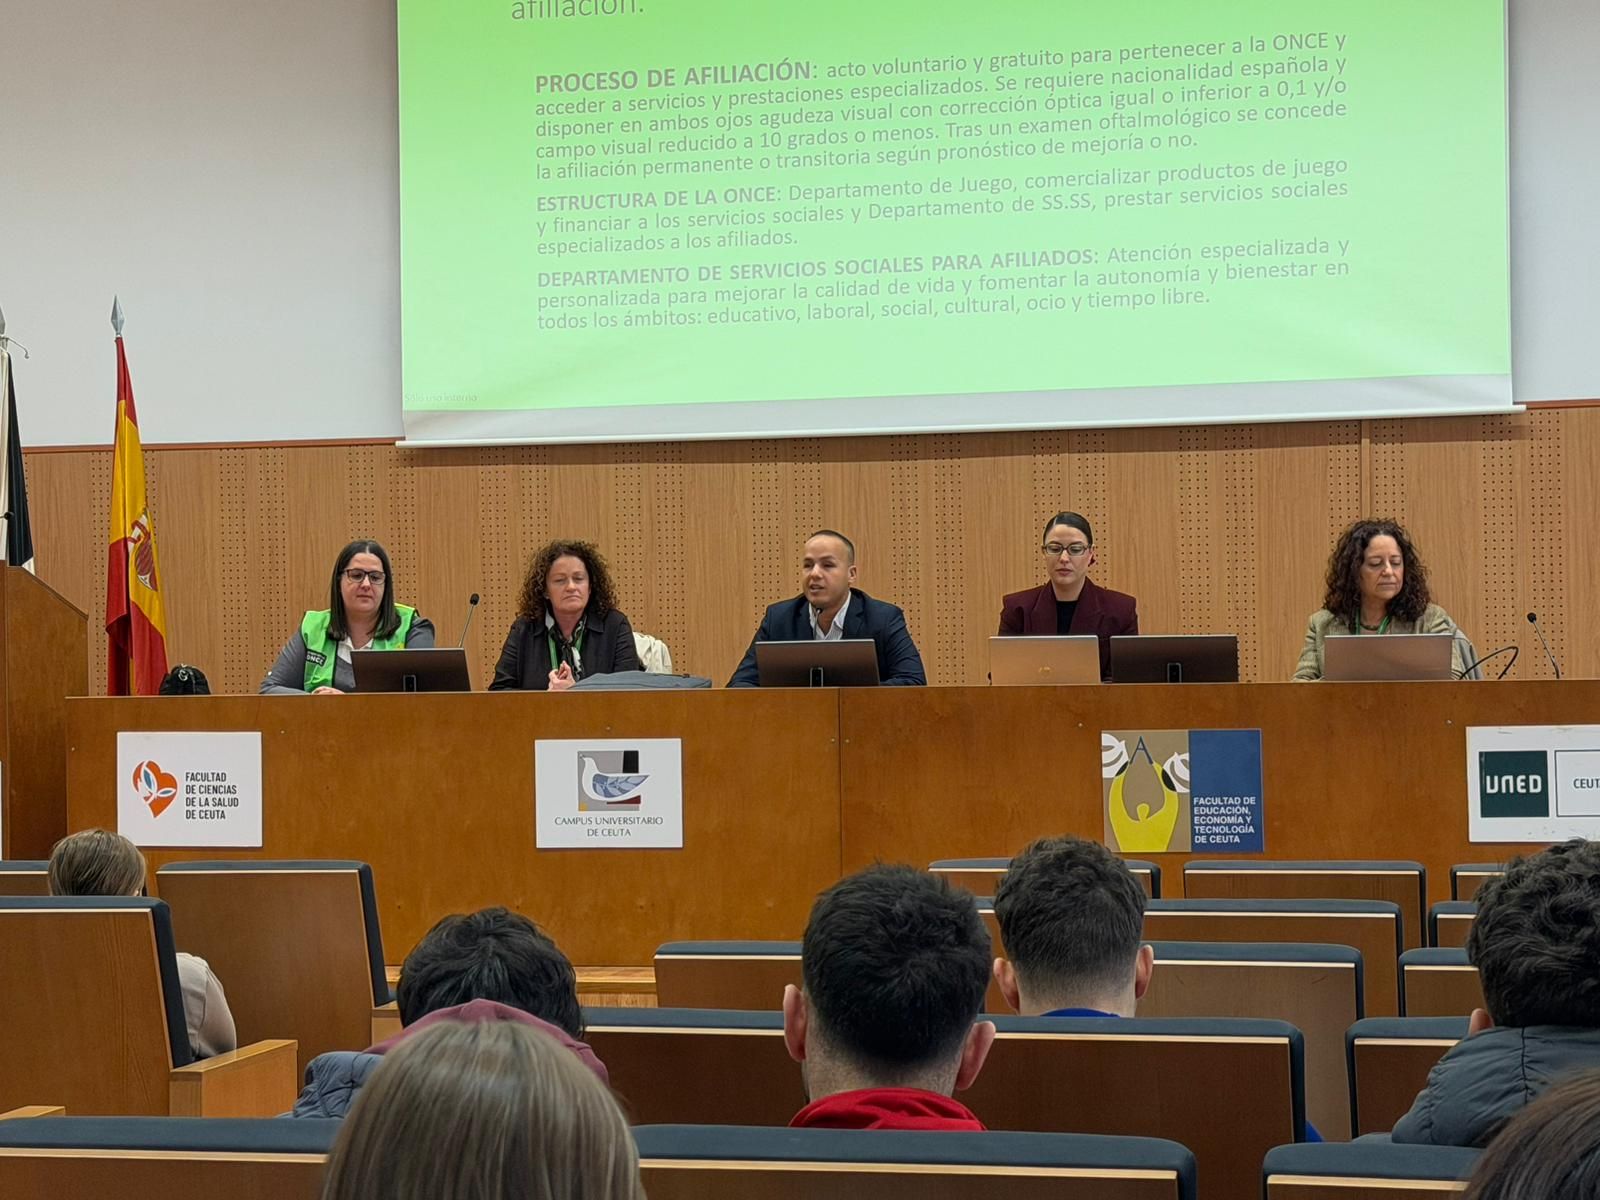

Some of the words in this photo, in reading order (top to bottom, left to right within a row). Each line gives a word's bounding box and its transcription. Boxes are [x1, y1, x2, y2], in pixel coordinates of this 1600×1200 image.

[536, 70, 638, 93] PROCESO
[648, 68, 676, 88] DE
[684, 58, 817, 86] AFILIACIÓN:
[827, 62, 866, 78] acto
[872, 55, 967, 75] voluntario
[973, 57, 983, 74] y
[990, 50, 1064, 72] gratuito
[1071, 50, 1112, 68] para
[1120, 42, 1226, 65] pertenecer
[1232, 41, 1242, 54] a
[1250, 35, 1265, 52] la
[1273, 32, 1328, 51] ONCE
[1335, 34, 1346, 51] y
[536, 97, 606, 116] acceder
[612, 100, 621, 112] a
[628, 92, 706, 111] servicios
[712, 94, 722, 111] y
[729, 87, 844, 110] prestaciones
[850, 77, 988, 102] especializados.
[995, 76, 1016, 91] Se
[1025, 71, 1104, 92] requiere
[1112, 60, 1232, 84] nacionalidad
[1241, 56, 1328, 79] española
[1336, 58, 1346, 75] y
[536, 120, 614, 140] disponer
[620, 120, 642, 133] en
[649, 114, 709, 132] ambos
[716, 112, 752, 131] ojos
[760, 107, 833, 129] agudeza
[840, 102, 892, 121] visual
[900, 105, 932, 118] con
[940, 95, 1037, 116] corrección
[1044, 92, 1102, 113] óptica
[1110, 88, 1154, 110] igual
[1162, 91, 1174, 104] o
[1181, 83, 1252, 102] inferior
[1259, 85, 1269, 98] a
[1277, 80, 1306, 100] 0,1
[1314, 75, 1346, 98] y/o
[536, 144, 596, 161] campo
[601, 137, 651, 155] visual
[659, 133, 737, 153] reducido
[744, 136, 753, 148] a
[760, 132, 781, 148] 10
[787, 128, 848, 150] grados
[854, 131, 866, 143] o
[872, 127, 939, 142] menos.
[945, 122, 982, 138] Tras
[989, 123, 1012, 136] un
[1018, 118, 1092, 134] examen
[1099, 107, 1230, 130] oftalmológico
[1237, 109, 1258, 122] se
[1264, 99, 1346, 120] concede
[537, 164, 550, 180] la
[556, 159, 636, 179] afiliación
[643, 156, 754, 179] permanente
[760, 157, 770, 169] o
[776, 149, 870, 168] transitoria
[877, 144, 930, 166] según
[938, 140, 1036, 164] pronóstico
[1042, 138, 1065, 155] de
[1072, 132, 1143, 156] mejoría
[1150, 136, 1162, 148] o
[1168, 134, 1197, 148] no.
[537, 192, 657, 212] ESTRUCTURA
[664, 190, 688, 206] DE
[695, 189, 717, 205] LA
[724, 186, 781, 203] ONCE:
[789, 180, 922, 203] Departamento
[930, 177, 952, 194] de
[959, 177, 1017, 194] Juego,
[1025, 168, 1151, 189] comercializar
[1158, 163, 1255, 186] productos
[1262, 159, 1286, 176] de
[1292, 158, 1347, 179] juego
[536, 221, 546, 238] y
[553, 215, 631, 232] financiar
[638, 217, 647, 229] a
[656, 212, 680, 228] los
[688, 209, 765, 227] servicios
[773, 205, 844, 223] sociales
[851, 208, 861, 224] y
[869, 198, 1004, 222] Departamento
[1012, 195, 1034, 212] de
[1042, 193, 1096, 212] SS.SS,
[1105, 190, 1173, 211] prestar
[1180, 184, 1263, 204] servicios
[1272, 180, 1348, 199] sociales
[537, 234, 665, 258] especializados
[670, 237, 680, 249] a
[686, 232, 711, 248] los
[717, 229, 798, 247] afiliados.
[538, 267, 689, 287] DEPARTAMENTO
[698, 266, 722, 281] DE
[730, 261, 826, 280] SERVICIOS
[834, 257, 924, 275] SOCIALES
[932, 254, 982, 271] PARA
[990, 249, 1098, 268] AFILIADOS:
[1107, 242, 1191, 263] Atención
[1201, 236, 1329, 262] especializada
[1338, 240, 1350, 256] y
[538, 288, 660, 312] personalizada
[668, 291, 706, 308] para
[715, 286, 786, 305] mejorar
[793, 282, 807, 299] la
[815, 279, 880, 298] calidad
[888, 278, 910, 295] de
[917, 276, 954, 294] vida
[962, 280, 972, 296] y
[979, 273, 1067, 291] fomentar
[1074, 270, 1088, 287] la
[1096, 264, 1200, 285] autonomía
[1208, 268, 1218, 284] y
[1226, 262, 1318, 280] bienestar
[1325, 262, 1349, 276] en
[537, 312, 588, 330] todos
[594, 312, 618, 328] los
[624, 310, 702, 327] ámbitos:
[707, 306, 800, 324] educativo,
[808, 301, 875, 320] laboral,
[881, 298, 938, 318] social,
[944, 295, 1020, 315] cultural,
[1026, 294, 1066, 311] ocio
[1071, 296, 1082, 312] y
[1087, 291, 1155, 310] tiempo
[1162, 287, 1210, 304] libre.
[185, 772, 227, 782] FACULTAD
[1485, 774, 1542, 794] UNED
[1573, 778, 1600, 789] CEUT
[185, 784, 196, 795] DE
[199, 784, 237, 795] CIENCIAS
[185, 797, 196, 807] DE
[199, 797, 209, 807] LA
[212, 797, 239, 807] SALUD
[1193, 796, 1241, 805] FACULTAD
[1243, 796, 1256, 805] DE
[185, 809, 196, 820] DE
[199, 809, 226, 820] CEUTA
[1194, 805, 1251, 815] EDUCACIÓN,
[554, 816, 593, 825] CAMPUS
[595, 816, 664, 825] UNIVERSITARIO
[1194, 815, 1244, 824] ECONOMÍA
[1245, 815, 1252, 824] Y
[587, 828, 599, 837] DE
[601, 828, 632, 837] CEUTA
[1194, 824, 1255, 834] TECNOLOGÍA
[1194, 835, 1207, 844] DE
[1209, 835, 1241, 844] CEUTA
